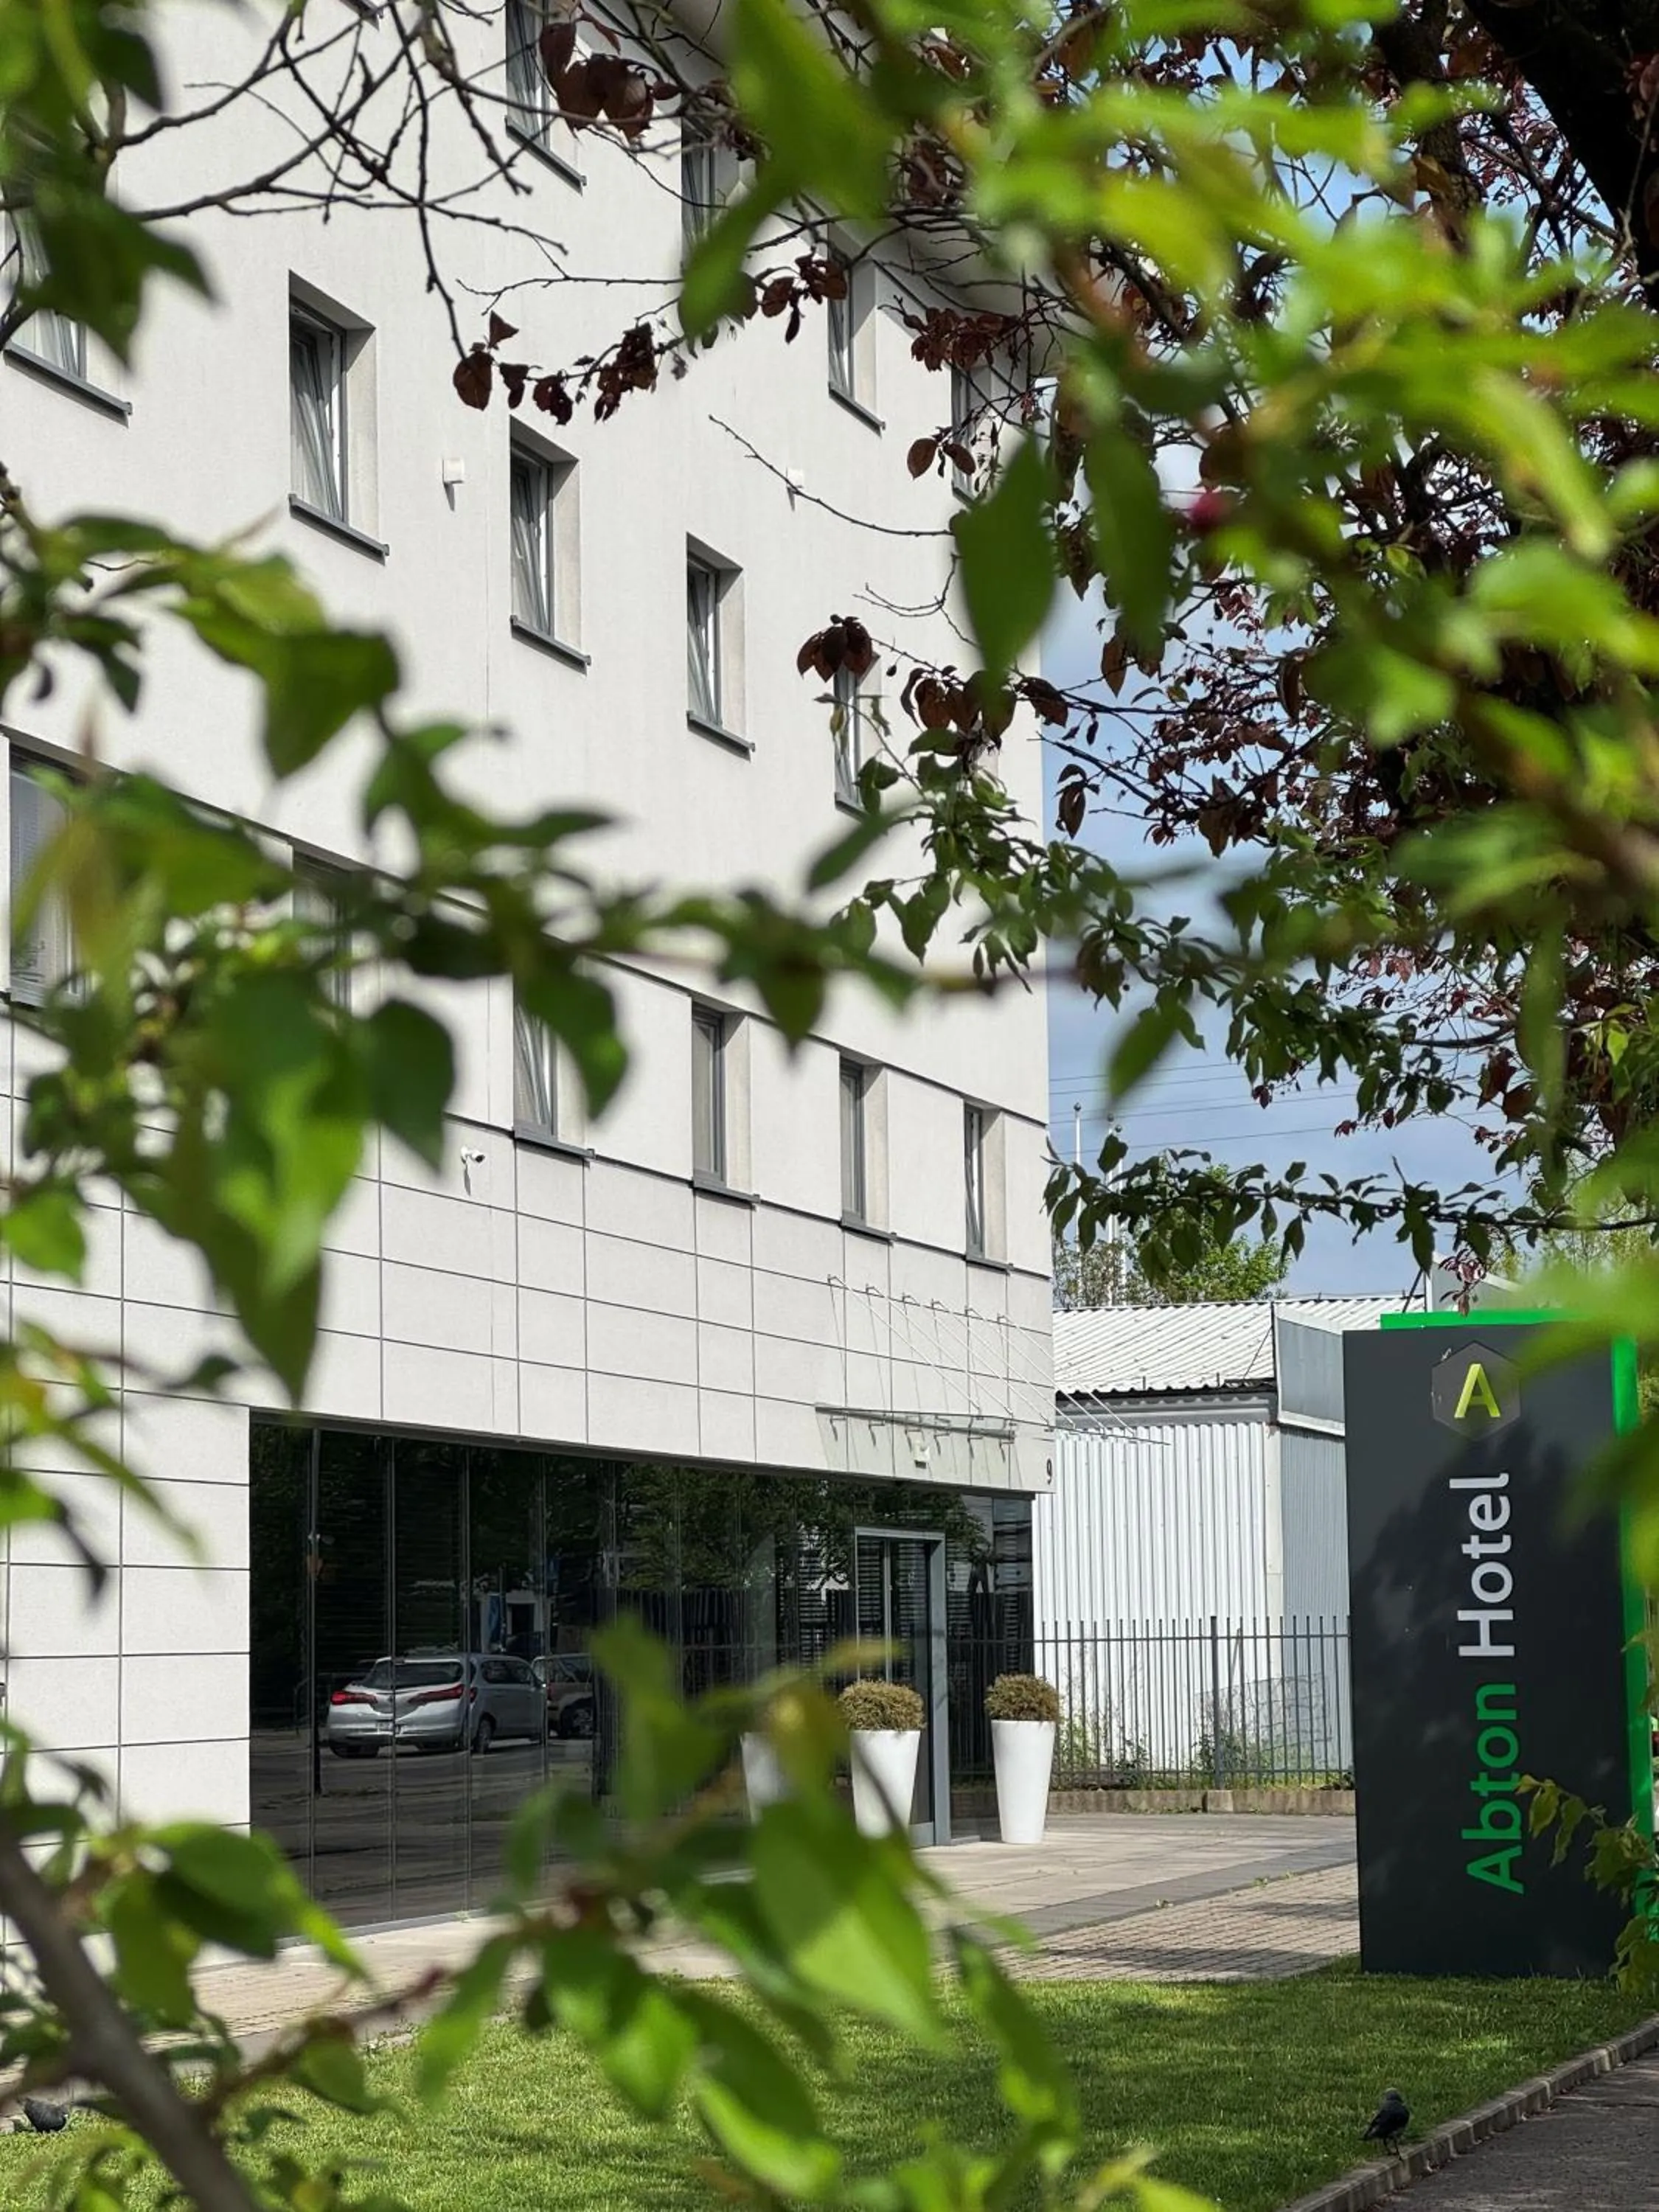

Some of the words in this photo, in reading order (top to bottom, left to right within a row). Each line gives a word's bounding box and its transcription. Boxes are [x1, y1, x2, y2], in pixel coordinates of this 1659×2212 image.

[1454, 1363, 1500, 1419] A
[1046, 1458, 1052, 1485] 9
[1449, 1472, 1514, 1658] Hotel
[1461, 1683, 1524, 1895] Abton
